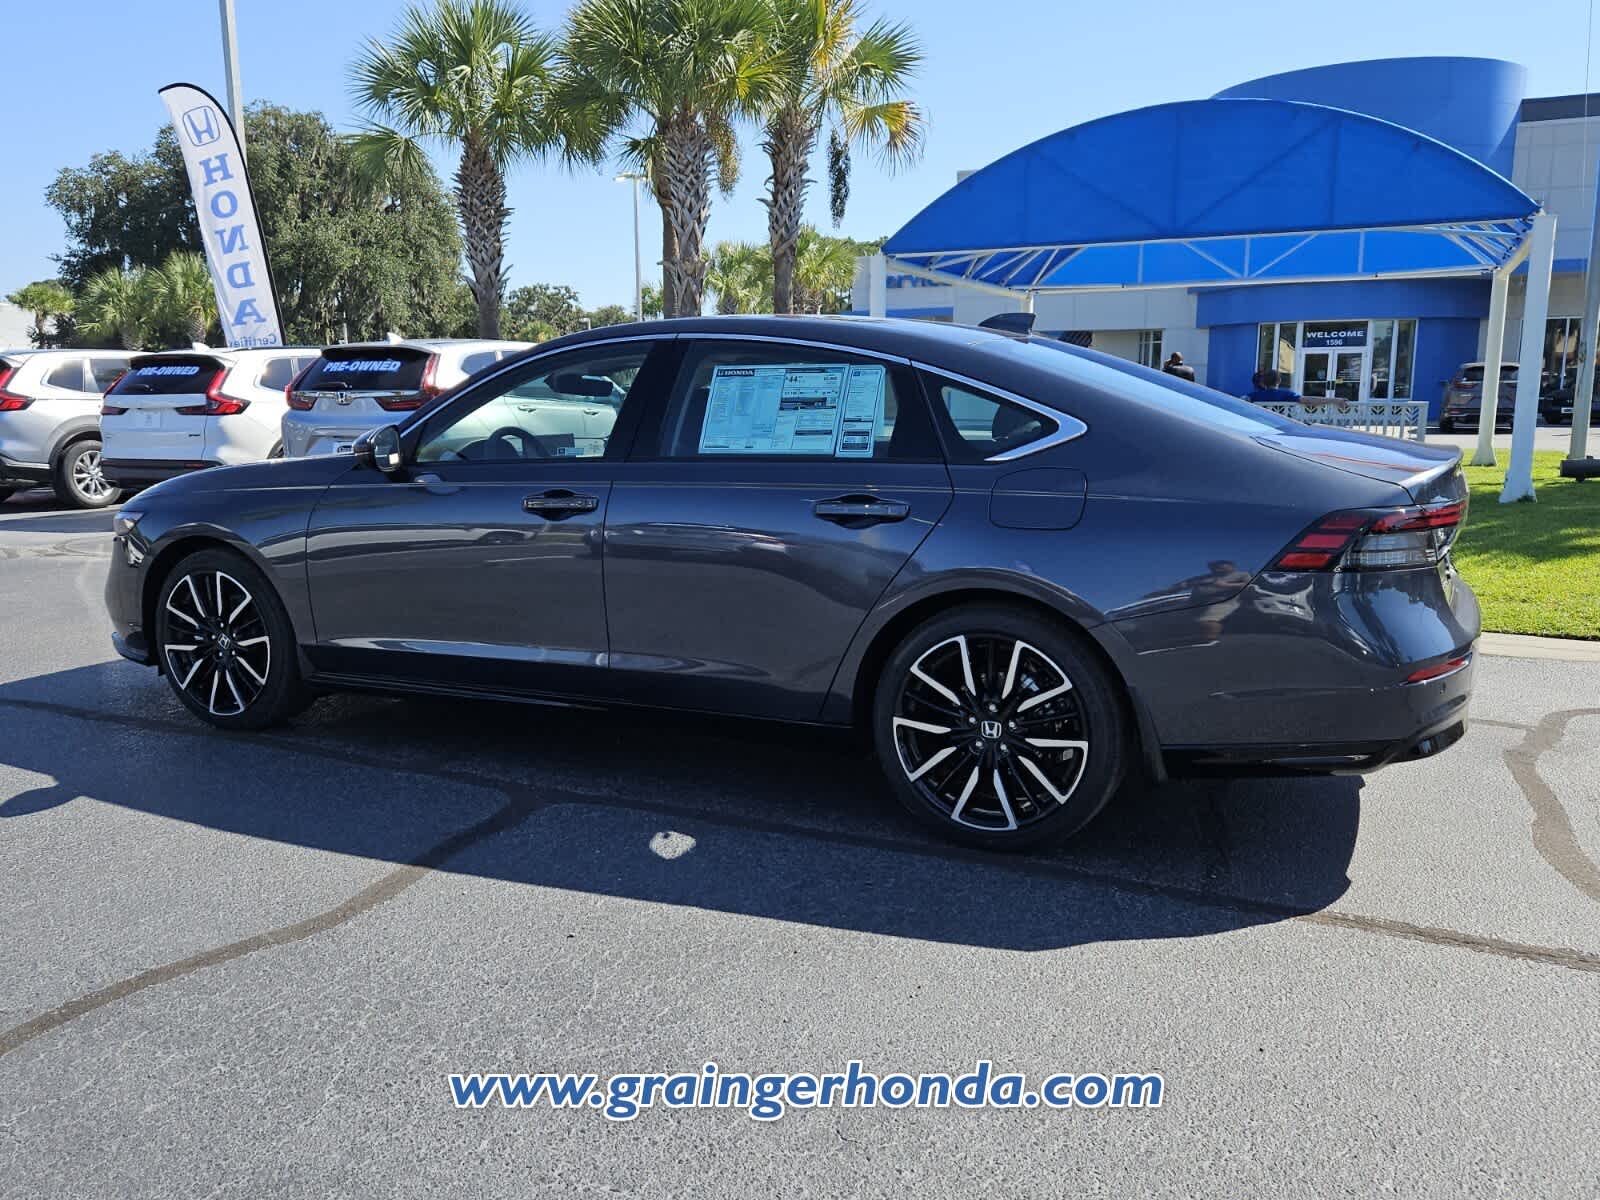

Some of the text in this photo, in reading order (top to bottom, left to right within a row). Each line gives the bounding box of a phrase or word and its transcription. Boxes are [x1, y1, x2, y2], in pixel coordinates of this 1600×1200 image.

[1306, 330, 1364, 338] WELCOME
[136, 366, 201, 376] PRE-OWNED
[322, 360, 401, 372] PRE-OWNED
